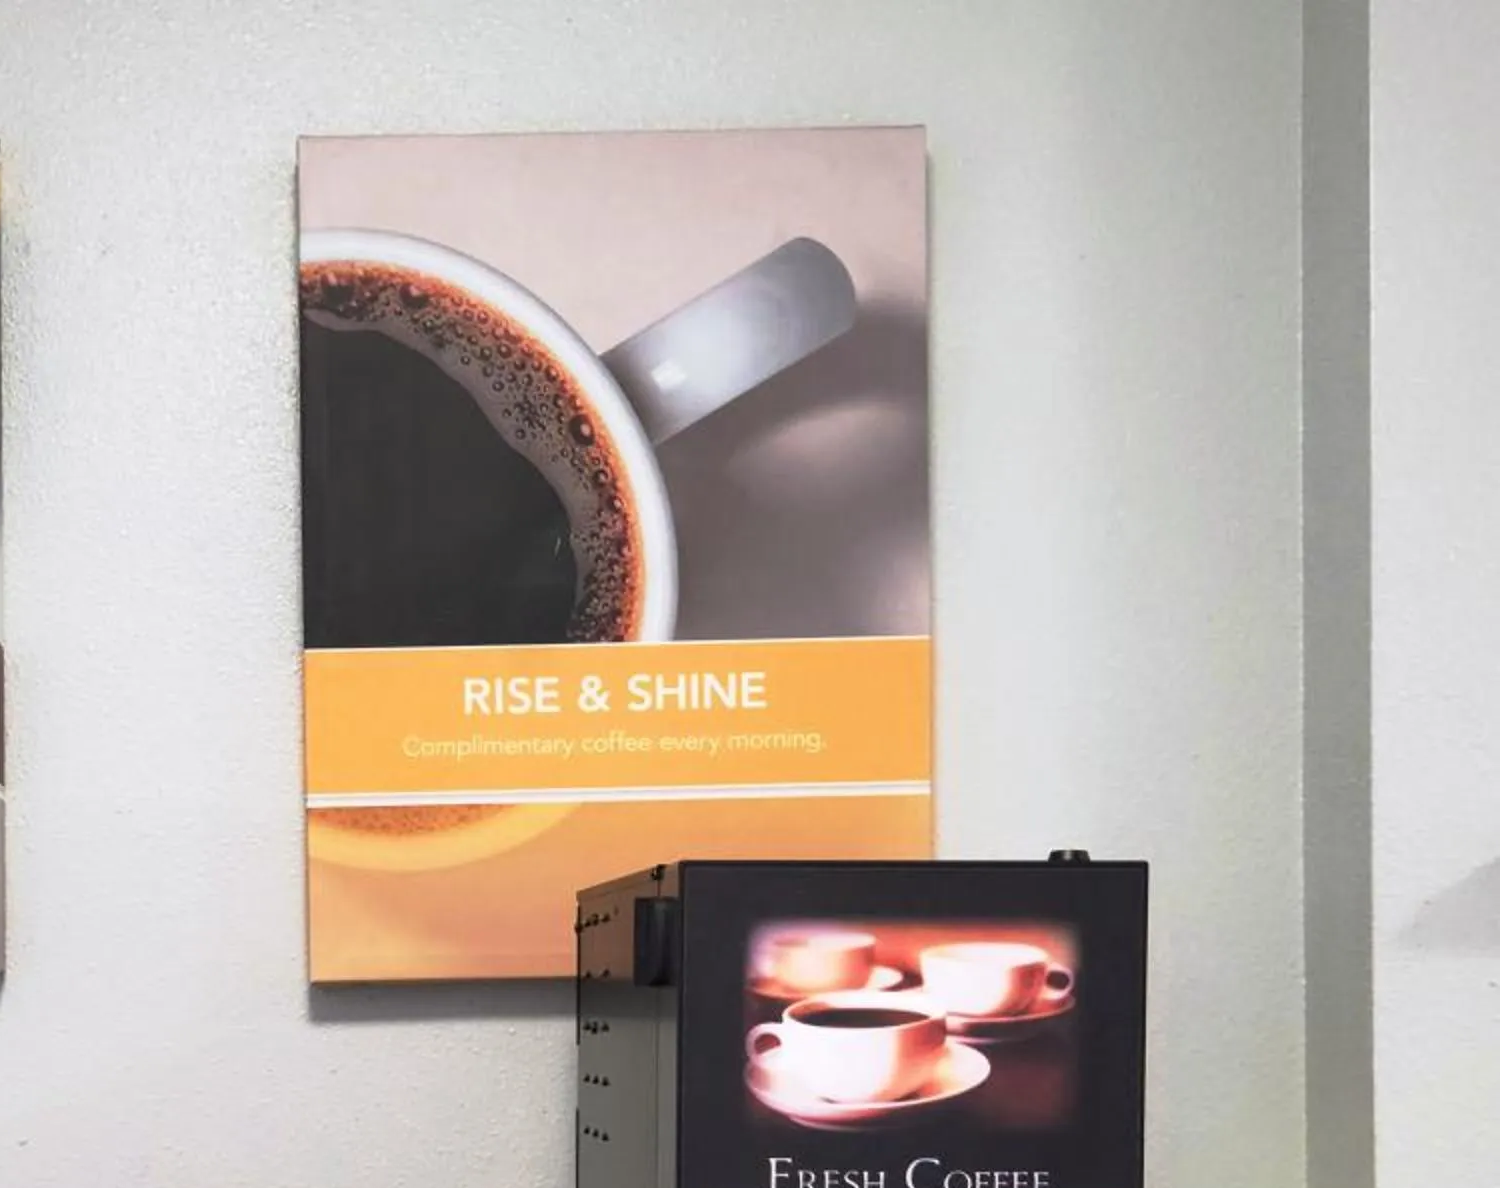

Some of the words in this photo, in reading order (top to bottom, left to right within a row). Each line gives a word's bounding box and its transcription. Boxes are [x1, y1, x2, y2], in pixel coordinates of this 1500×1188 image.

[463, 676, 560, 715] RISE
[577, 675, 611, 712] &
[627, 671, 767, 711] SHINE
[402, 732, 575, 761] Complimentary
[581, 730, 653, 753] coffee
[657, 734, 720, 757] every
[726, 730, 828, 755] morning.
